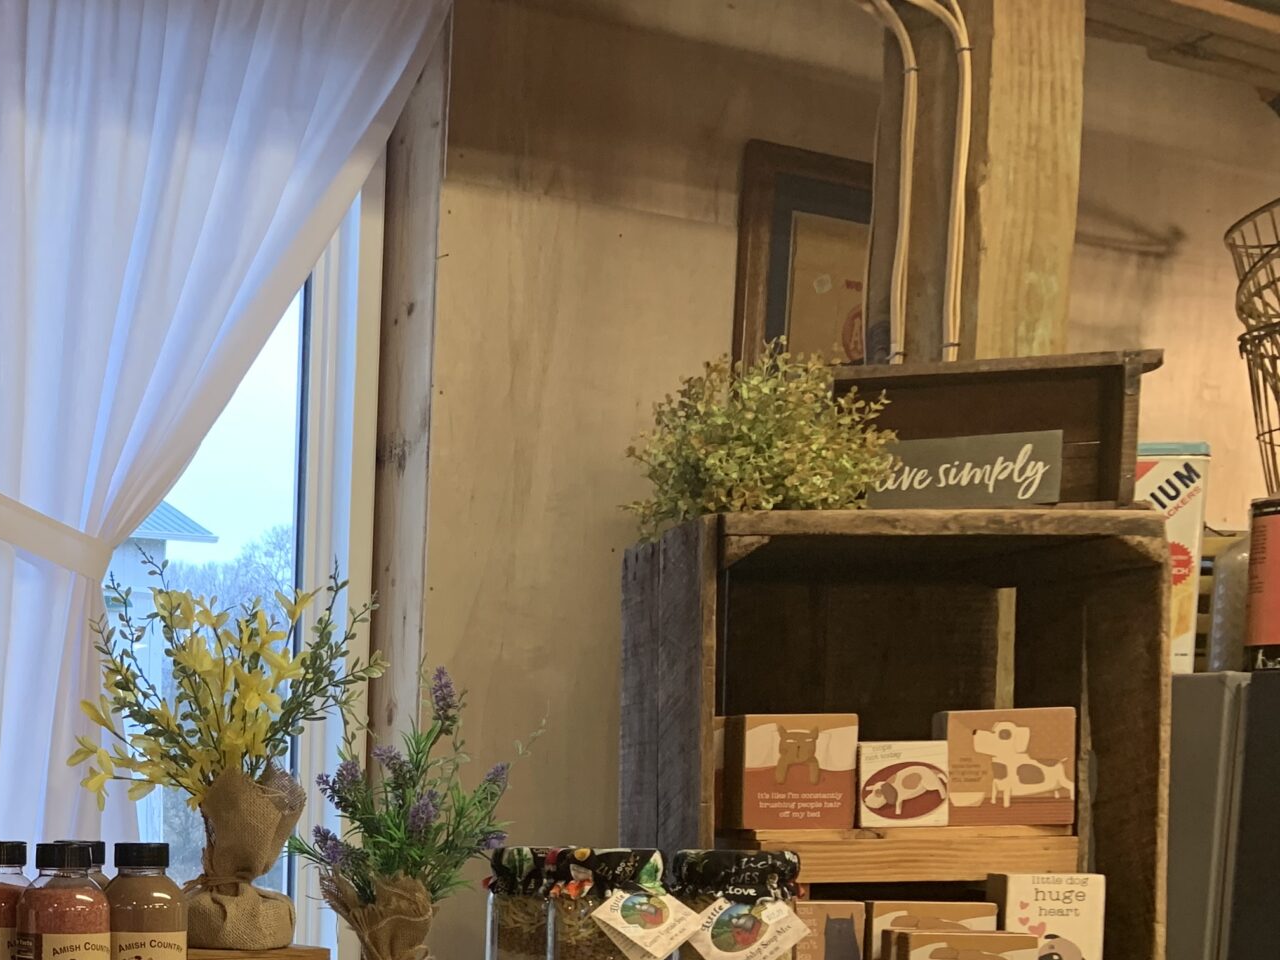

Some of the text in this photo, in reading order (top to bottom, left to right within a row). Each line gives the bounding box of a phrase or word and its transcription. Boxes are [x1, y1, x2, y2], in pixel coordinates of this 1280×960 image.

[937, 443, 1050, 499] simply
[1150, 462, 1201, 509] IUM
[1165, 486, 1202, 520] CKERS
[1031, 875, 1089, 887] little dog
[1034, 887, 1086, 904] huge
[1038, 905, 1080, 917] heart
[118, 940, 146, 953] AMISH
